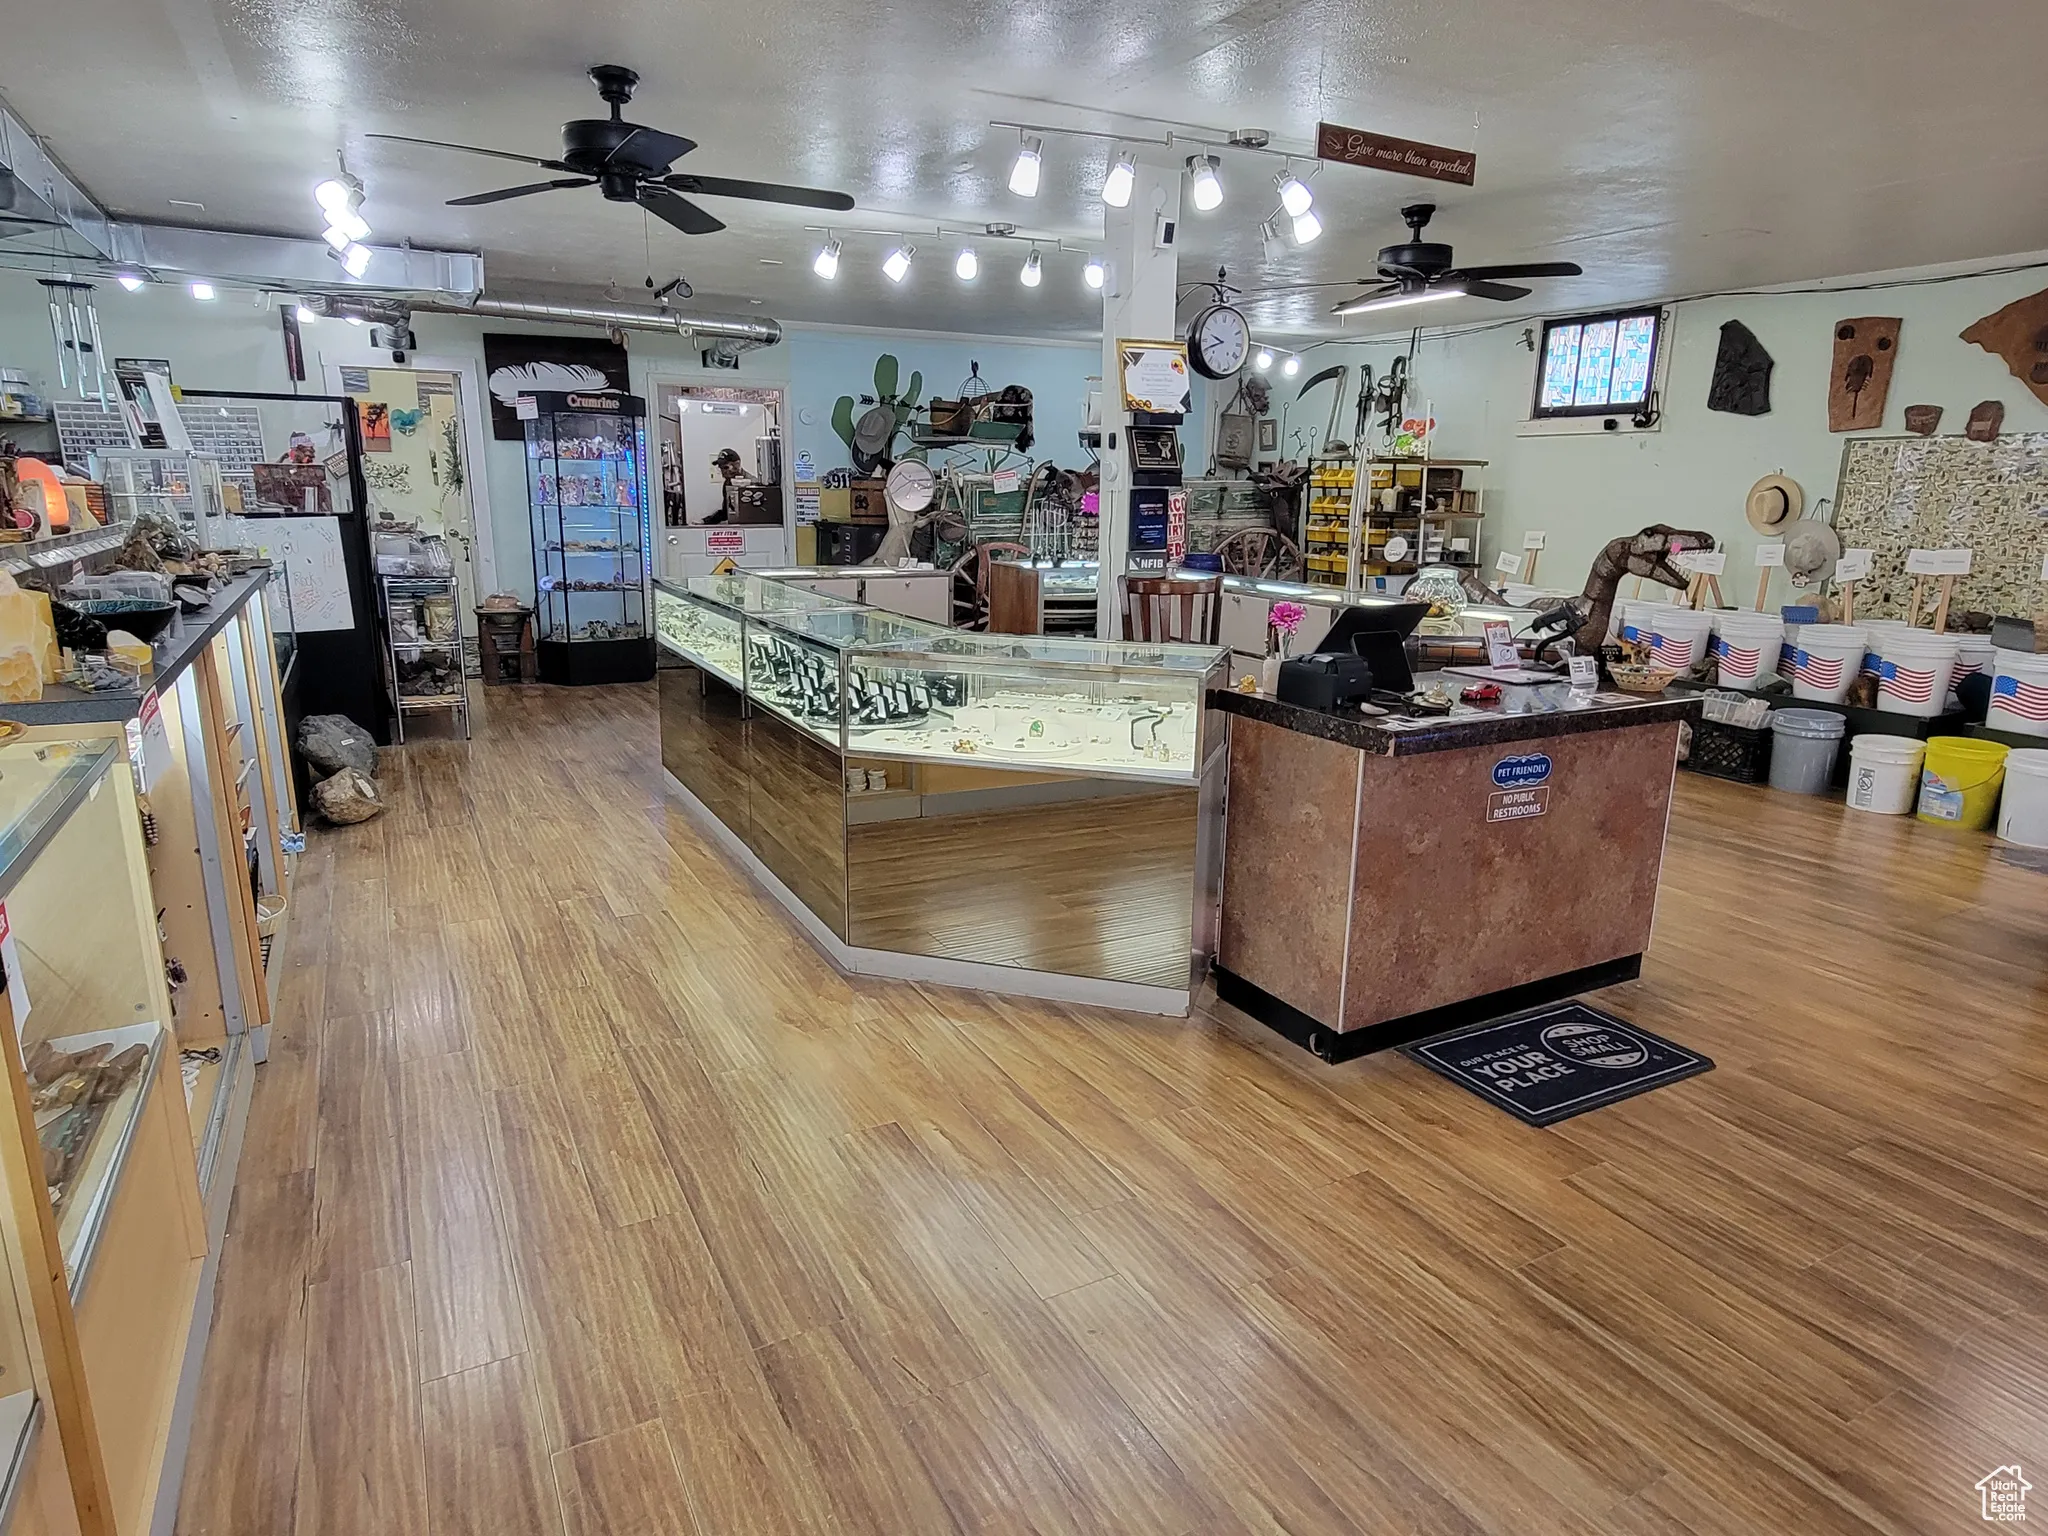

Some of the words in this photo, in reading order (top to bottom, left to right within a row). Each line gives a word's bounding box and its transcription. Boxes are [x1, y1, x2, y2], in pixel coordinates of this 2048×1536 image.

[1345, 134, 1374, 159] Give
[1376, 149, 1403, 162] more
[1405, 150, 1428, 168] than
[1430, 159, 1472, 176] expected.
[566, 393, 620, 409] Crumrine
[1141, 558, 1164, 569] NFIB
[1497, 768, 1511, 778] PET
[1512, 764, 1547, 776] FRIENDLY
[1502, 794, 1513, 805] NO
[1513, 791, 1535, 804] PUBLIC
[1493, 803, 1541, 819] RESTROOMS
[1561, 1034, 1611, 1049] SHOP
[1569, 1041, 1633, 1057] SMALL
[1459, 1056, 1483, 1068] OUR
[1484, 1047, 1516, 1062] PLACE
[1517, 1043, 1531, 1052] IS
[1473, 1051, 1554, 1080] YOUR
[1495, 1062, 1577, 1093] PLACE
